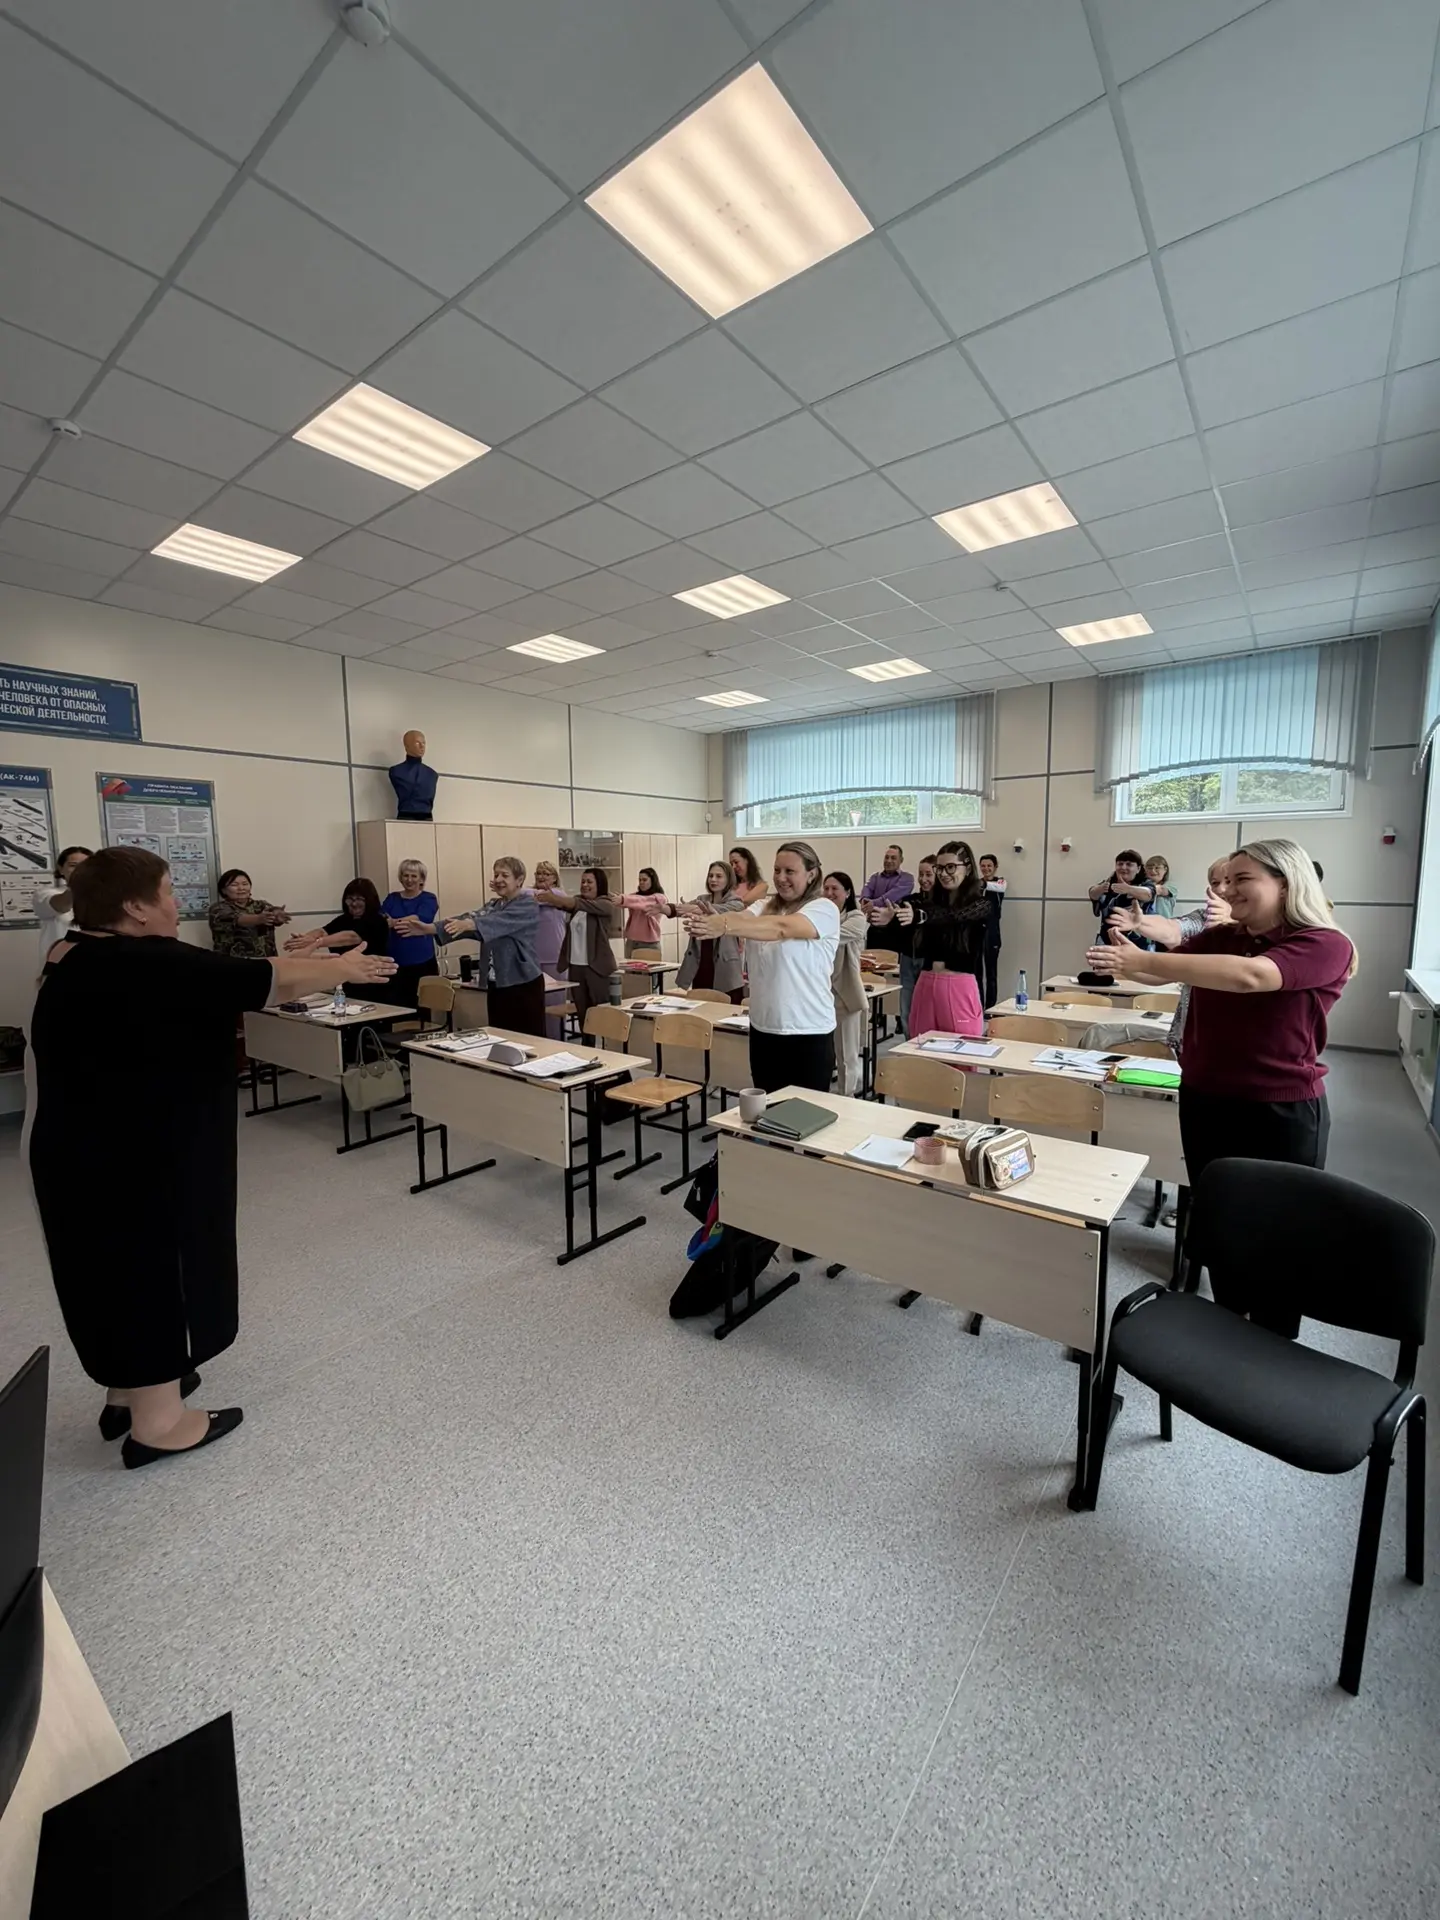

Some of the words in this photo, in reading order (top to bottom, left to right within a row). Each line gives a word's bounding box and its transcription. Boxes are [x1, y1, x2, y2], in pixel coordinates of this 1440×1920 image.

[12, 679, 60, 695] НАУЧНЫХ
[0, 691, 48, 706] ЧЕЛОВЕКА
[50, 697, 62, 707] ОТ
[63, 699, 107, 713] ОПАСНЫХ
[37, 708, 109, 725] ДЕЯТЕЛЬНОСТИ.
